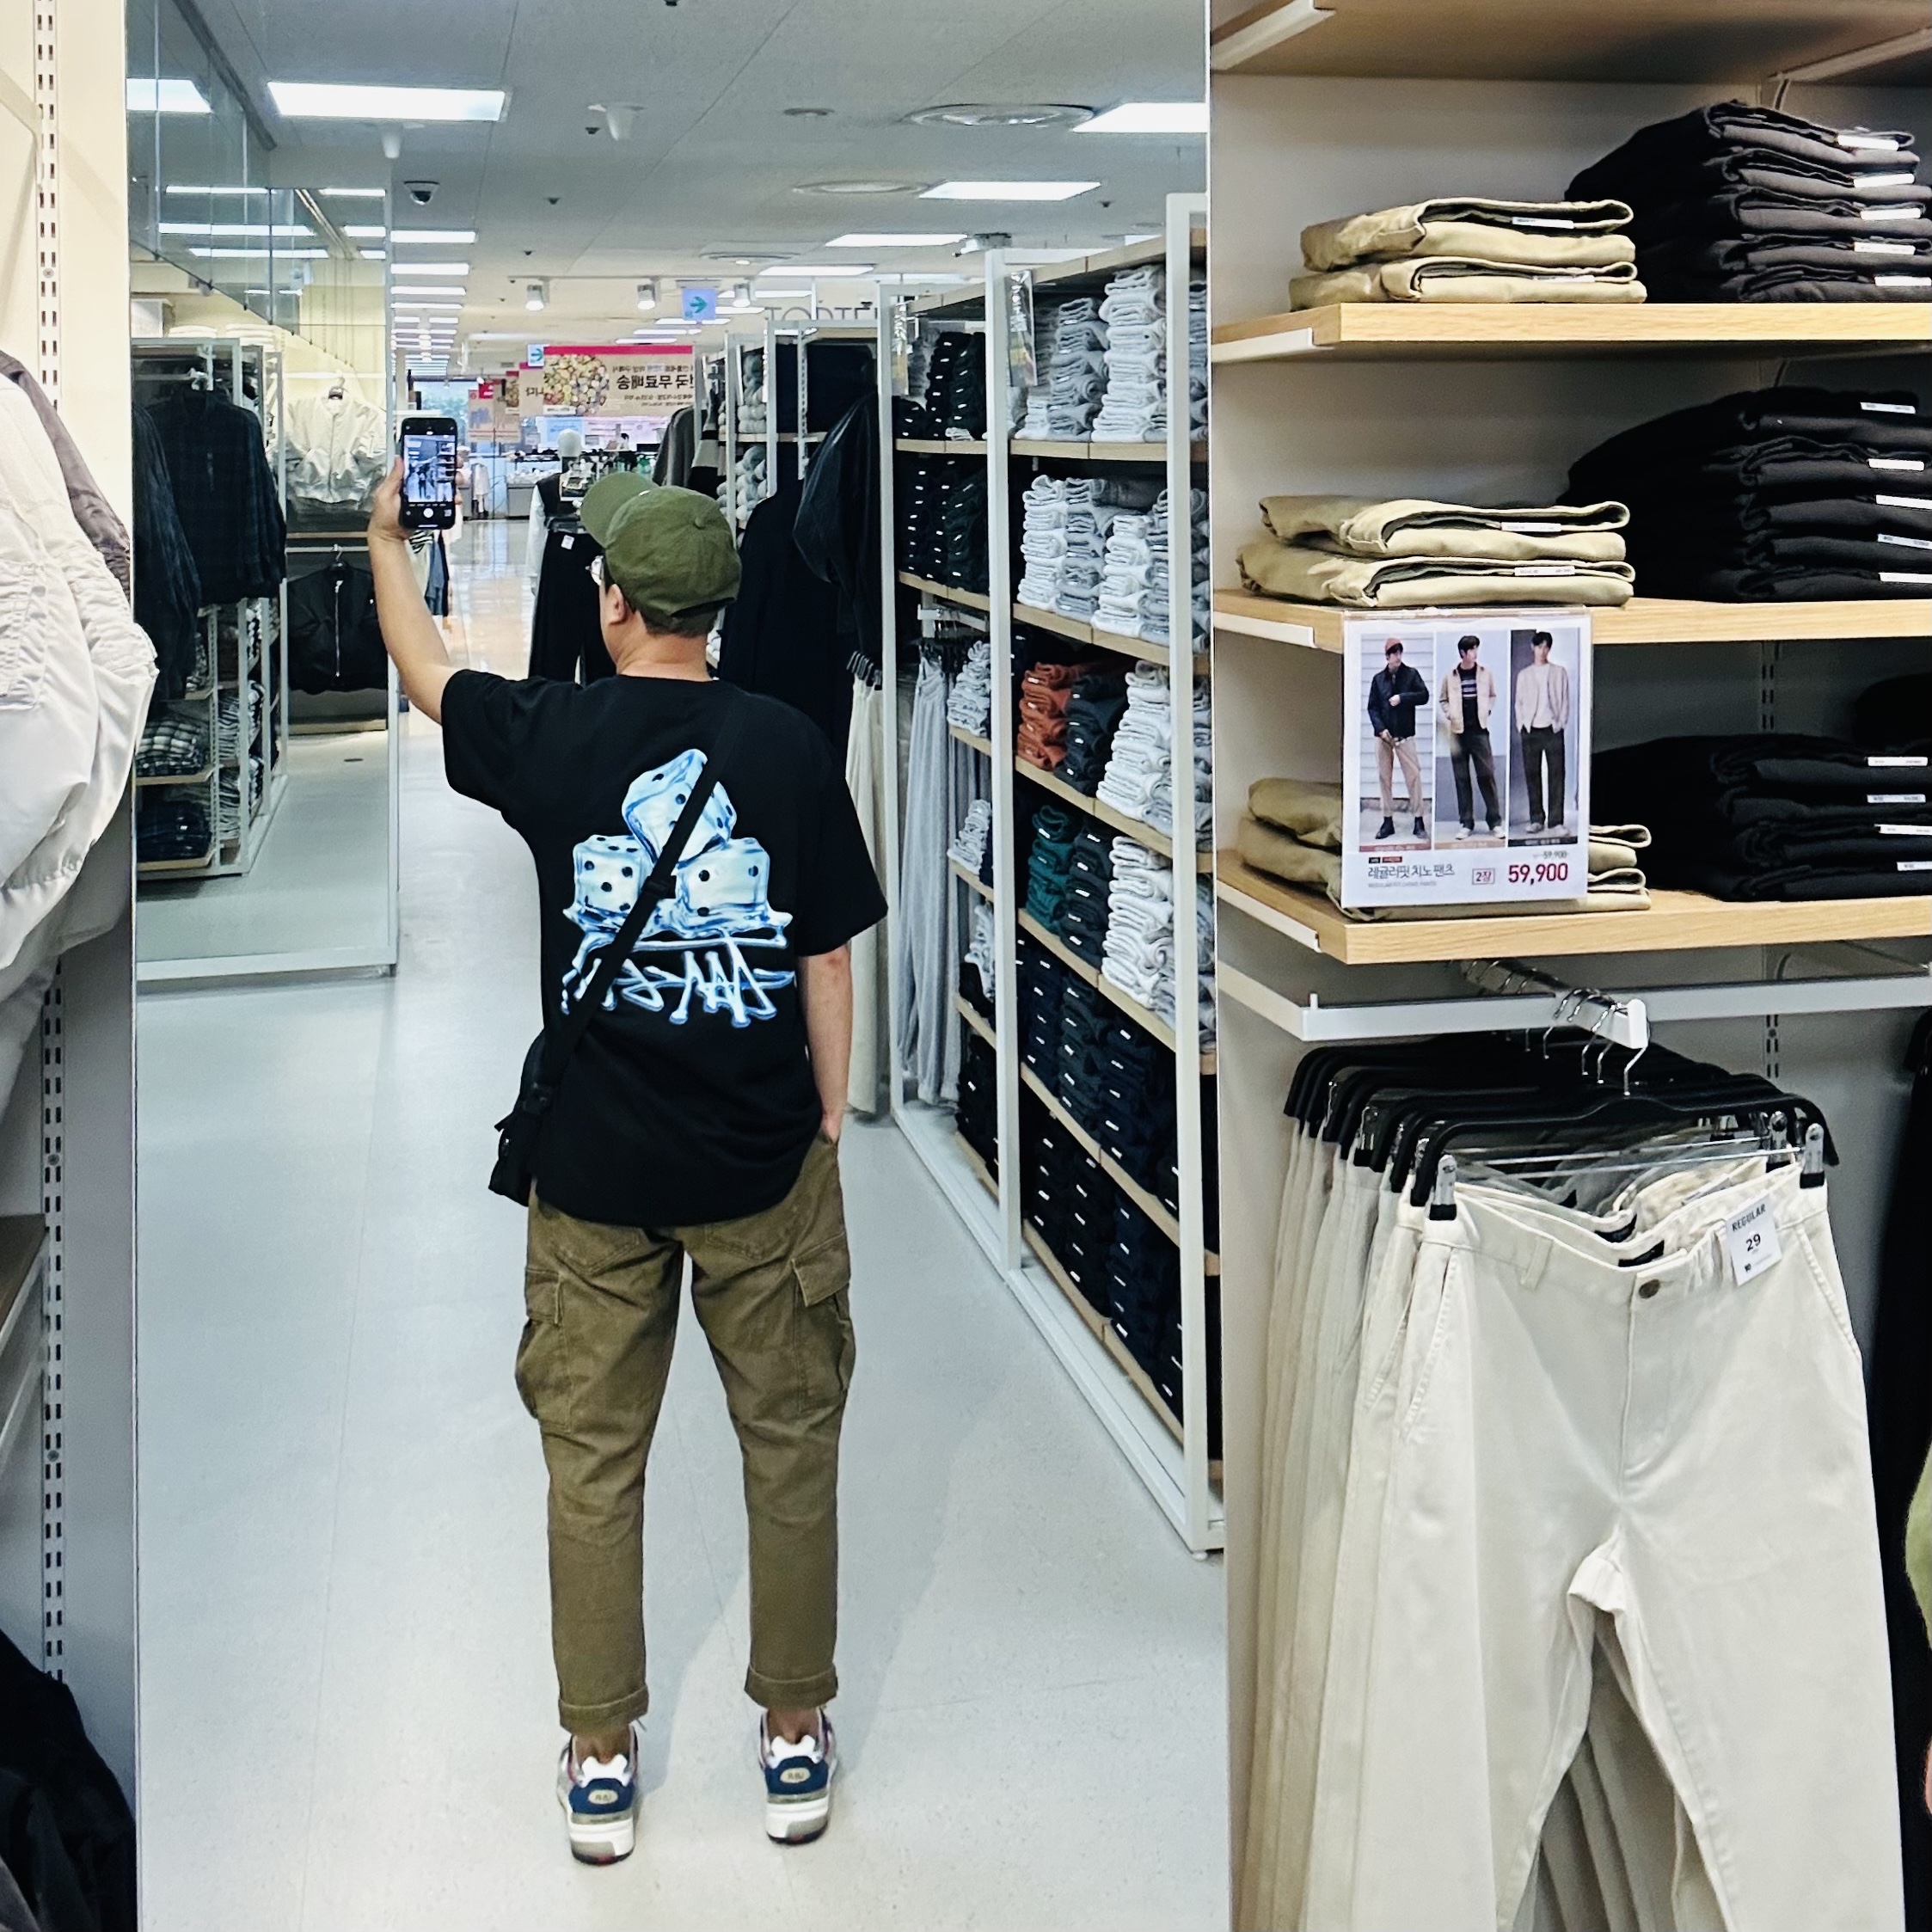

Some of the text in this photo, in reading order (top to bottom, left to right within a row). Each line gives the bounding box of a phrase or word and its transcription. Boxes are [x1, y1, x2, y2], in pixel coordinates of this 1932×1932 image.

[1367, 862, 1456, 880] 레귤러핏 치노 팬츠
[1475, 870, 1492, 882] 2장
[1507, 862, 1569, 886] 59,900
[1731, 1203, 1766, 1232] REGULAR
[1745, 1233, 1761, 1252] 29
